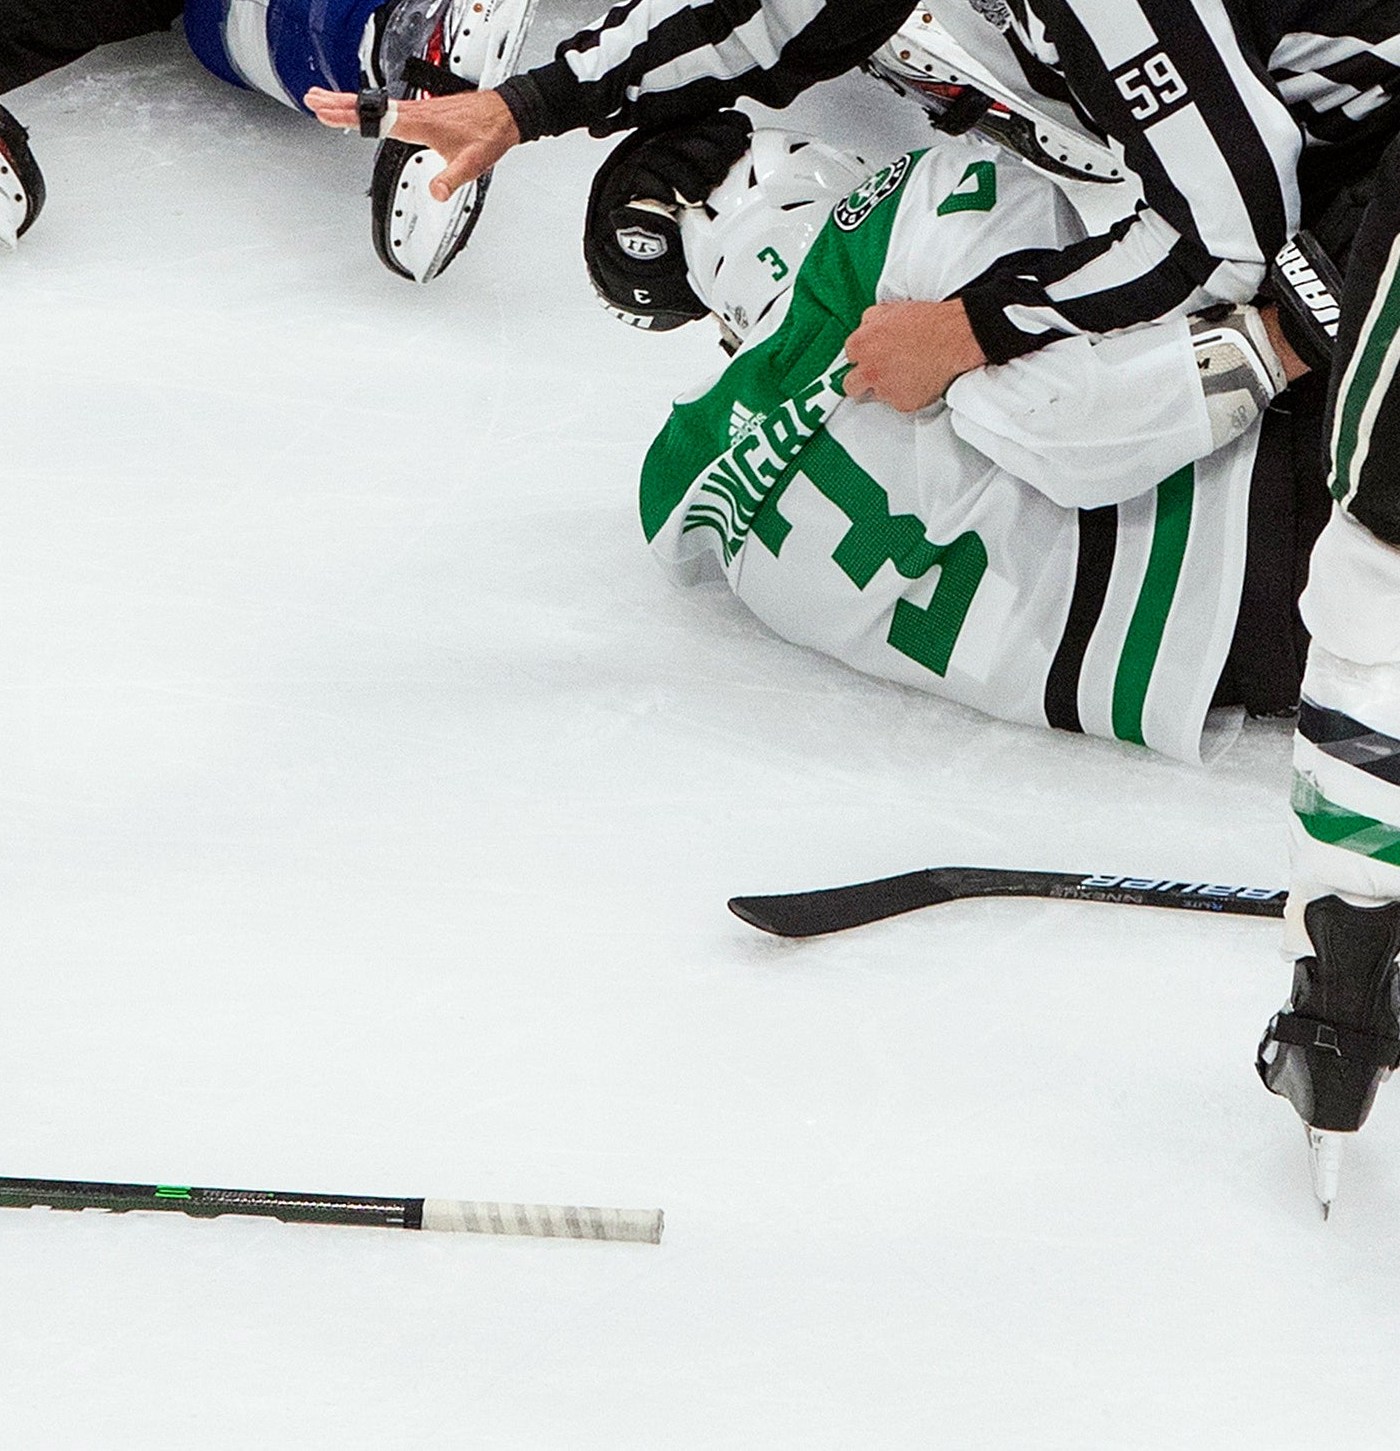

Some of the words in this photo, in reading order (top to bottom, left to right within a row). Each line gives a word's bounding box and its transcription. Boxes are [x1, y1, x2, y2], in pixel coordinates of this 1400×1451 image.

[1113, 51, 1189, 121] 59
[756, 245, 789, 282] 3
[747, 422, 989, 678] 3
[1081, 874, 1289, 900] BAUER
